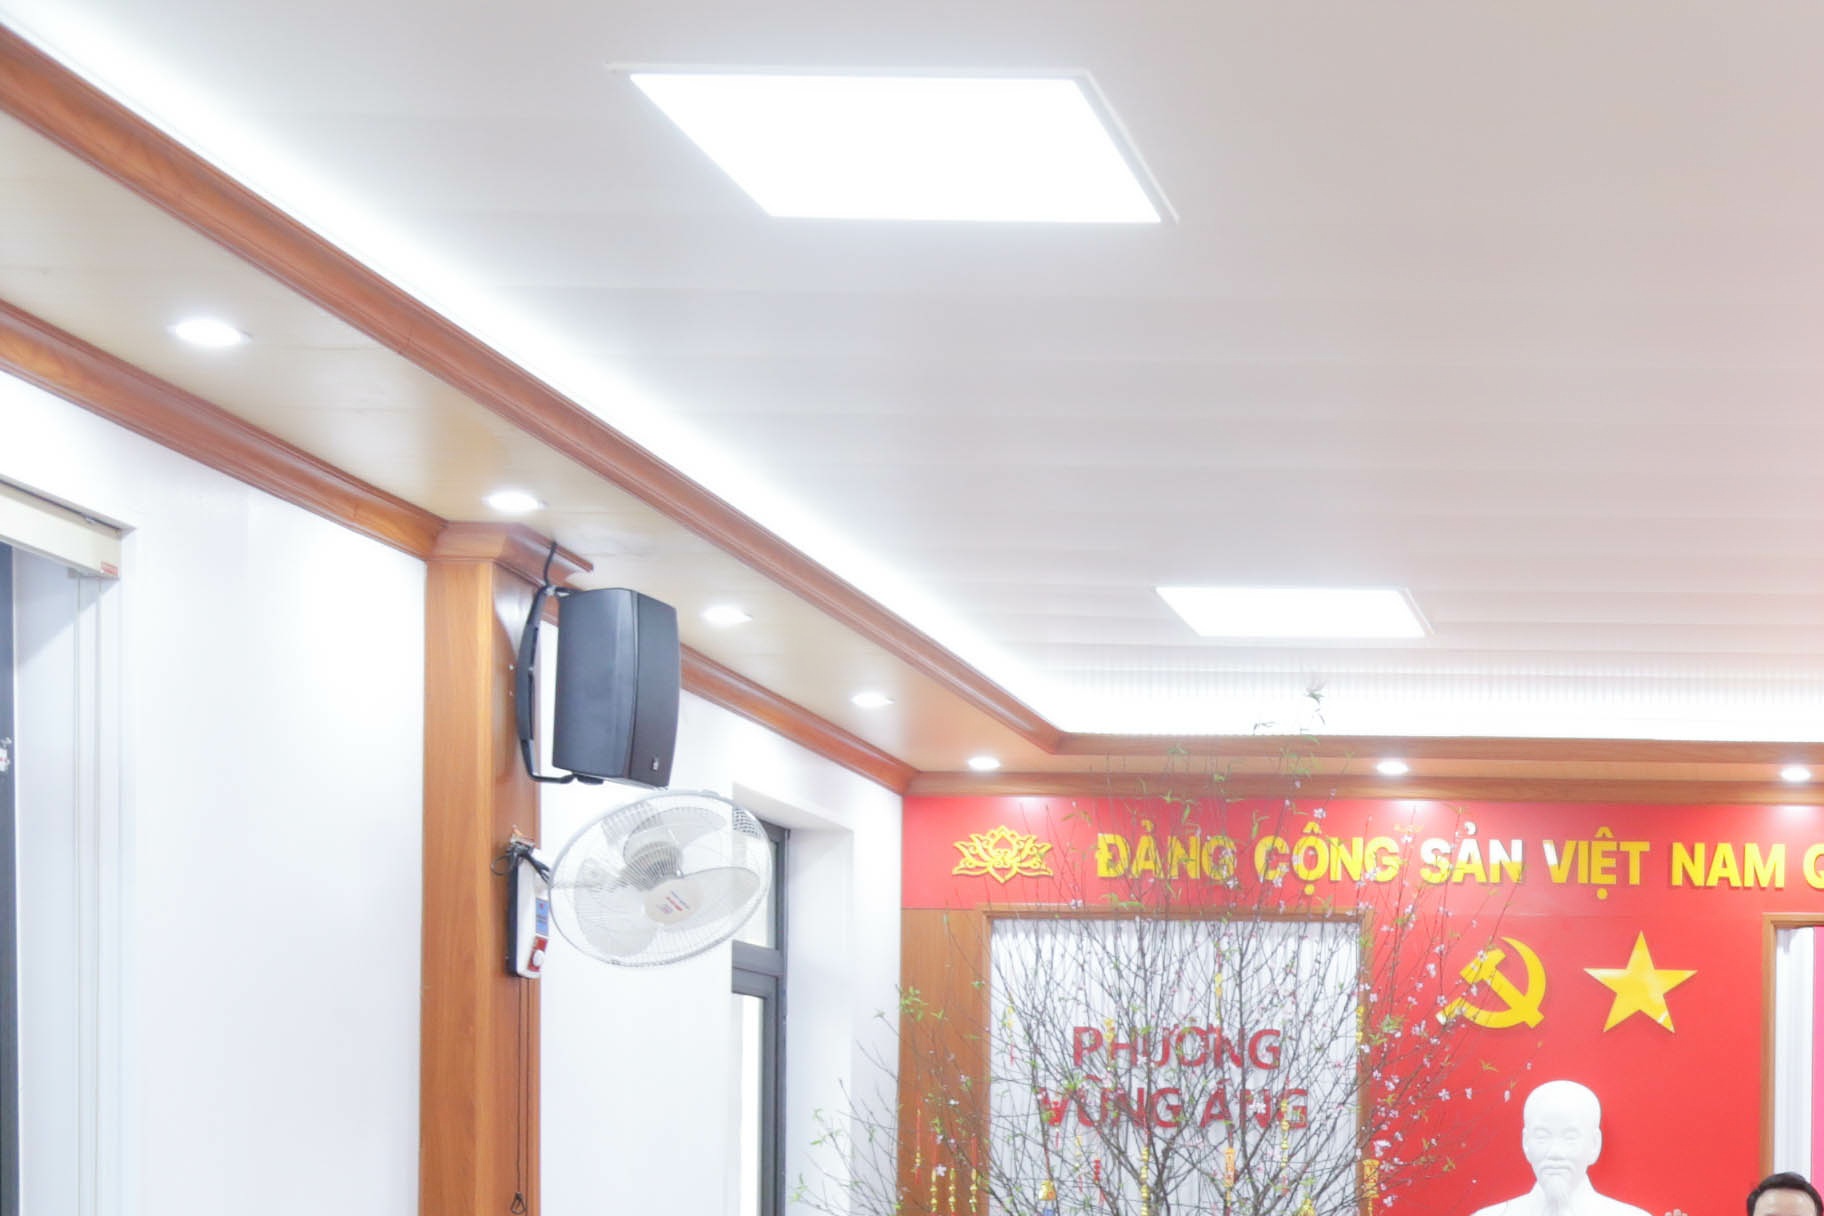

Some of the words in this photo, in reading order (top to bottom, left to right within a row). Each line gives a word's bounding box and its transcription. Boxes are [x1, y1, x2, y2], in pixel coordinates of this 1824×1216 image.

[1095, 820, 1237, 881] ĐẢNG
[1254, 821, 1402, 896] CỘNG
[1419, 821, 1524, 885] SẢN
[1542, 826, 1650, 900] VIỆT
[1671, 842, 1786, 888] NAM
